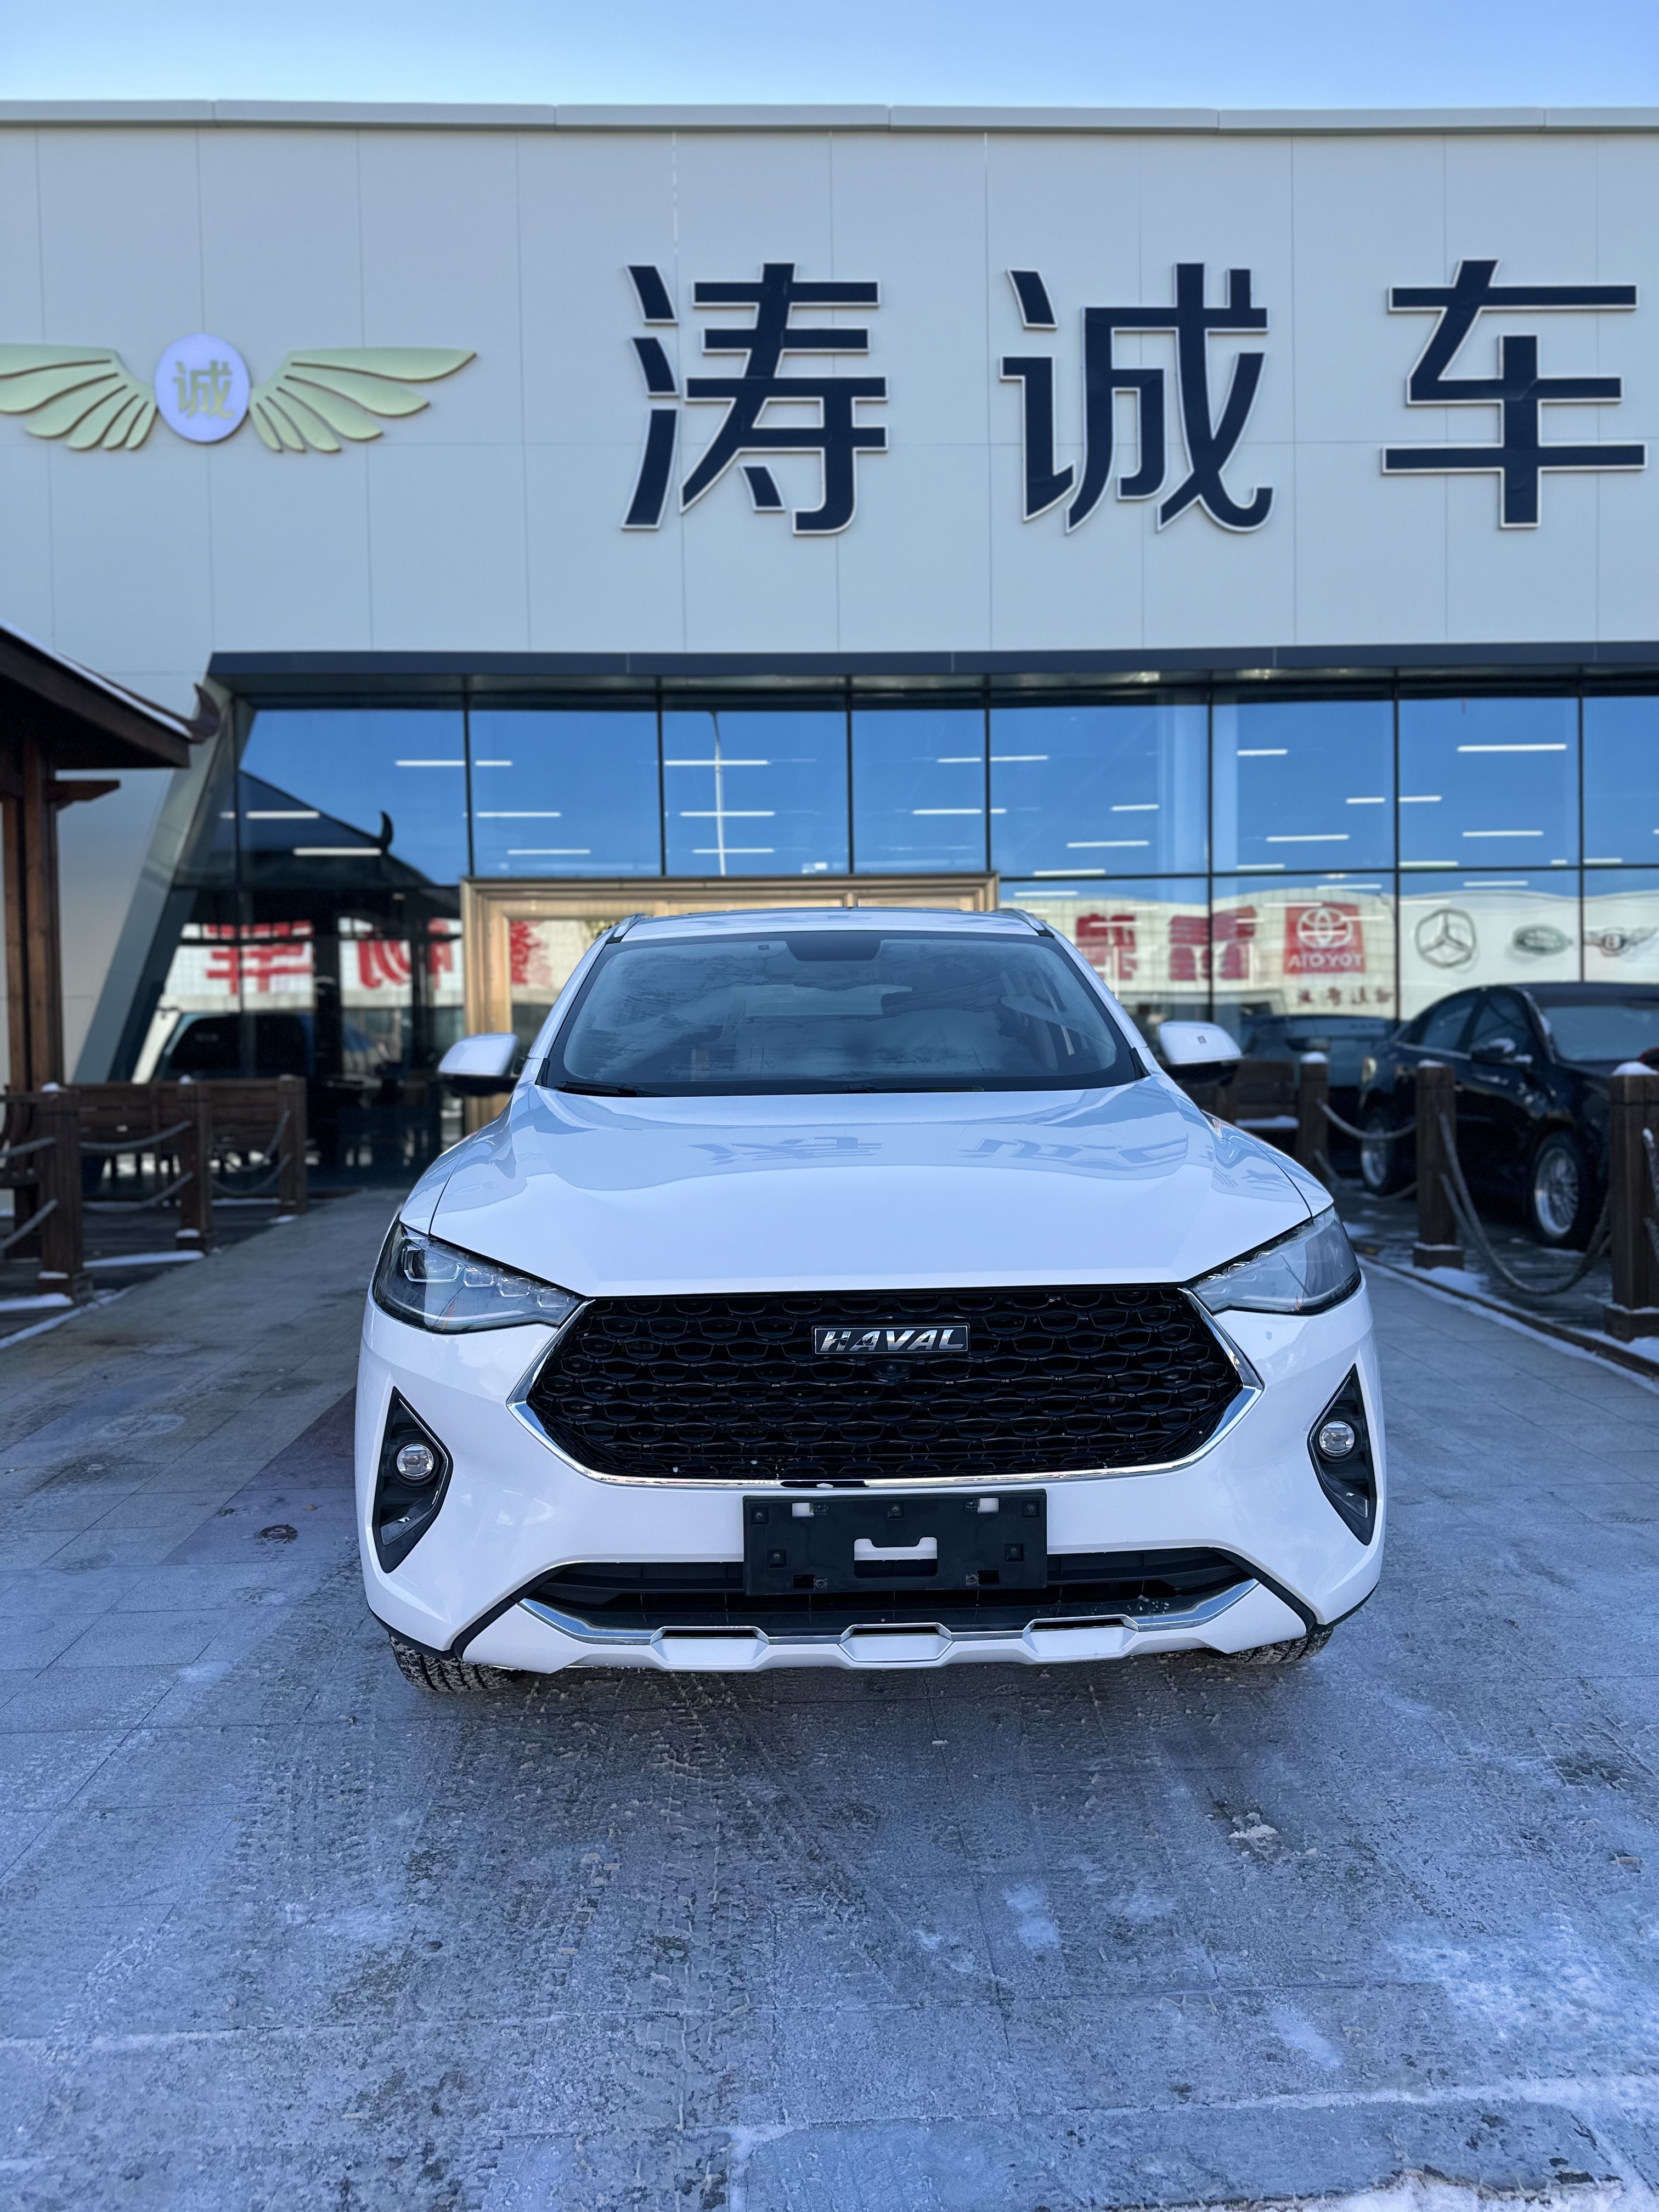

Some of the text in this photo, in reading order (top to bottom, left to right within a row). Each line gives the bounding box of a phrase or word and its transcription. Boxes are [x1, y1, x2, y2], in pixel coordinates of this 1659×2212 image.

[173, 360, 234, 419] 诚
[622, 259, 1646, 535] 涛诚车
[820, 1329, 964, 1351] HAVAL
